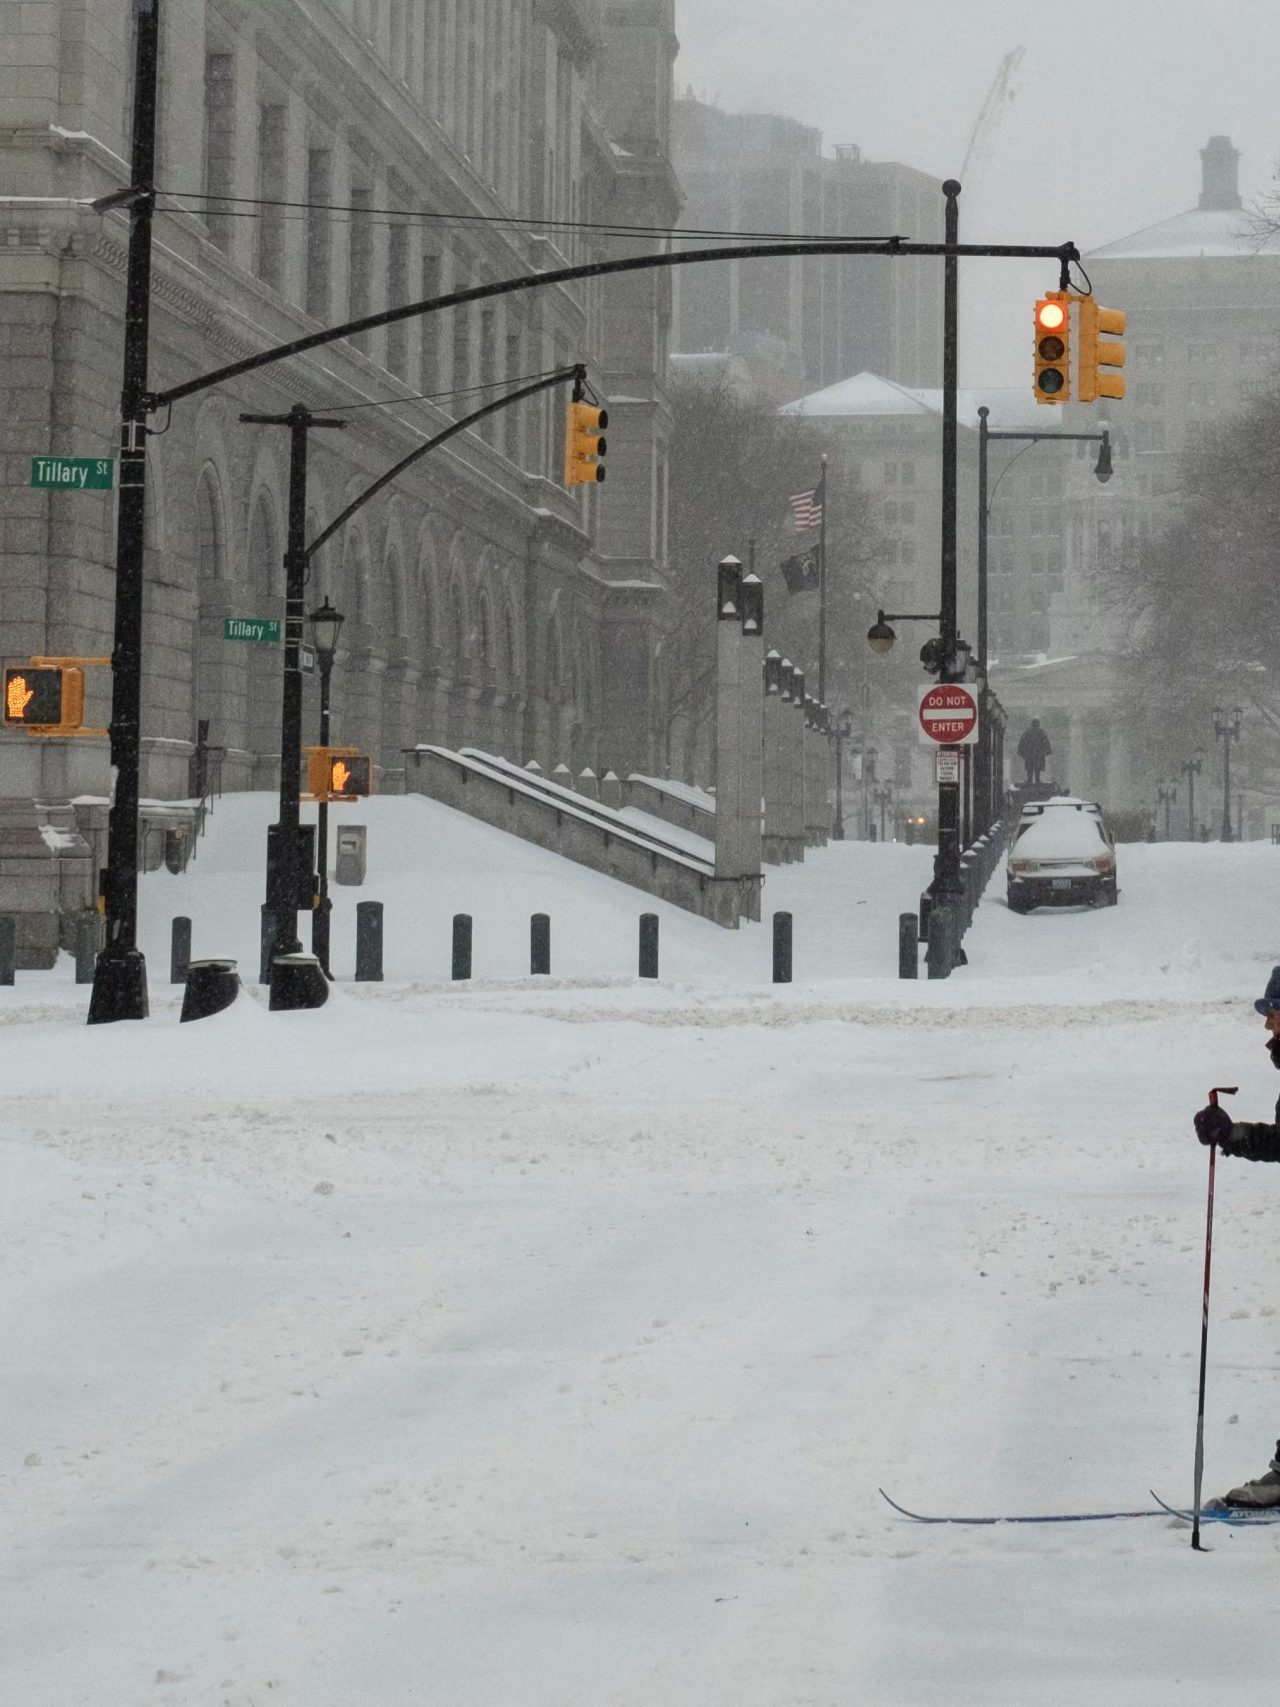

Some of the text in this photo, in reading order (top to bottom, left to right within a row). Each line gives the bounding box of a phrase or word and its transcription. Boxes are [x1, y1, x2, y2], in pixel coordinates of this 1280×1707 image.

[37, 461, 108, 488] Tillary St
[229, 620, 264, 641] Tillary
[929, 696, 967, 706] DO NOT
[932, 722, 964, 732] ENTER
